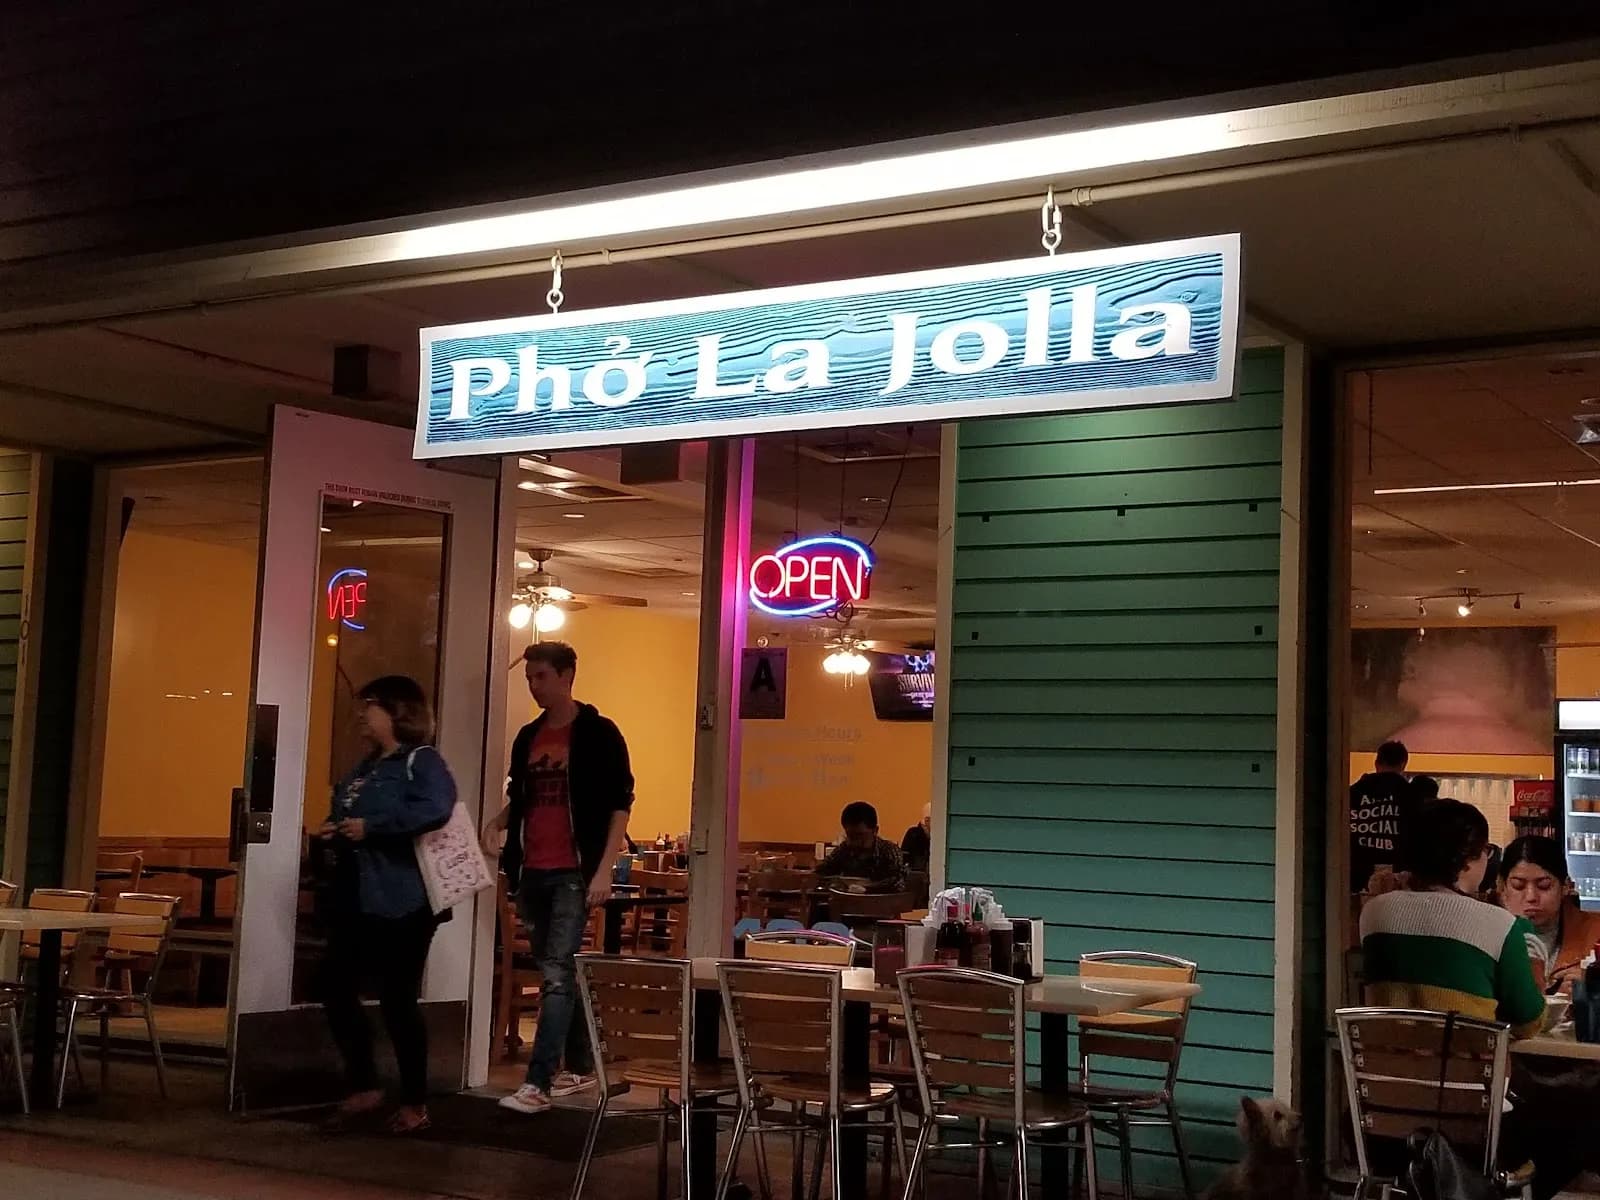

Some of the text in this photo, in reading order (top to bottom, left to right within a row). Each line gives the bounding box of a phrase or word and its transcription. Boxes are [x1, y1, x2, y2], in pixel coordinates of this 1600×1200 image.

[446, 285, 1199, 421] Phở La Jolla
[750, 554, 864, 601] OPEN
[750, 655, 777, 694] A
[1350, 804, 1400, 820] SOCIAL
[1350, 820, 1400, 835] SOCIAL
[1358, 836, 1394, 850] CLUB
